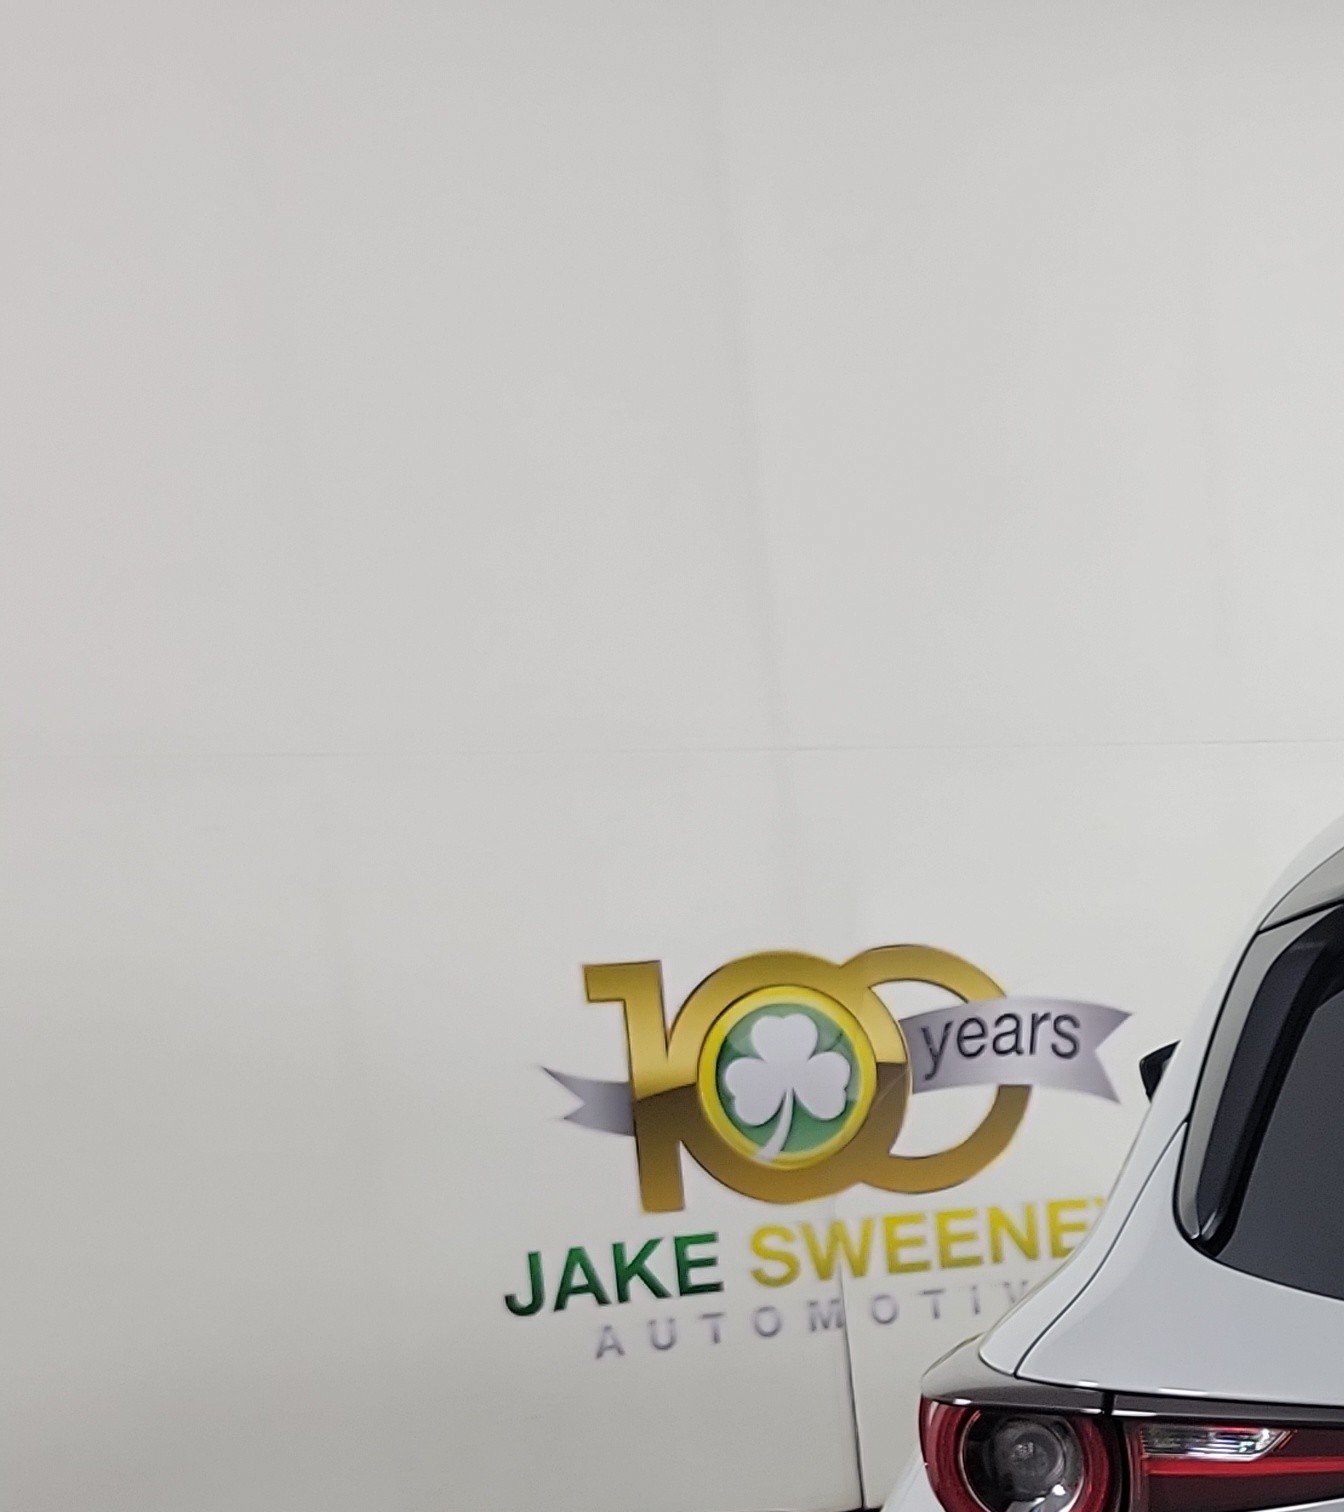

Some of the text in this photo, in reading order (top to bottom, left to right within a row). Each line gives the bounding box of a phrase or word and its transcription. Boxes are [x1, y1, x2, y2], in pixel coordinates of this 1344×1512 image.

[920, 1009, 1084, 1081] years
[503, 1196, 1106, 1318] JAKE SWEENE
[594, 1278, 1032, 1362] AUTOMOTIV
